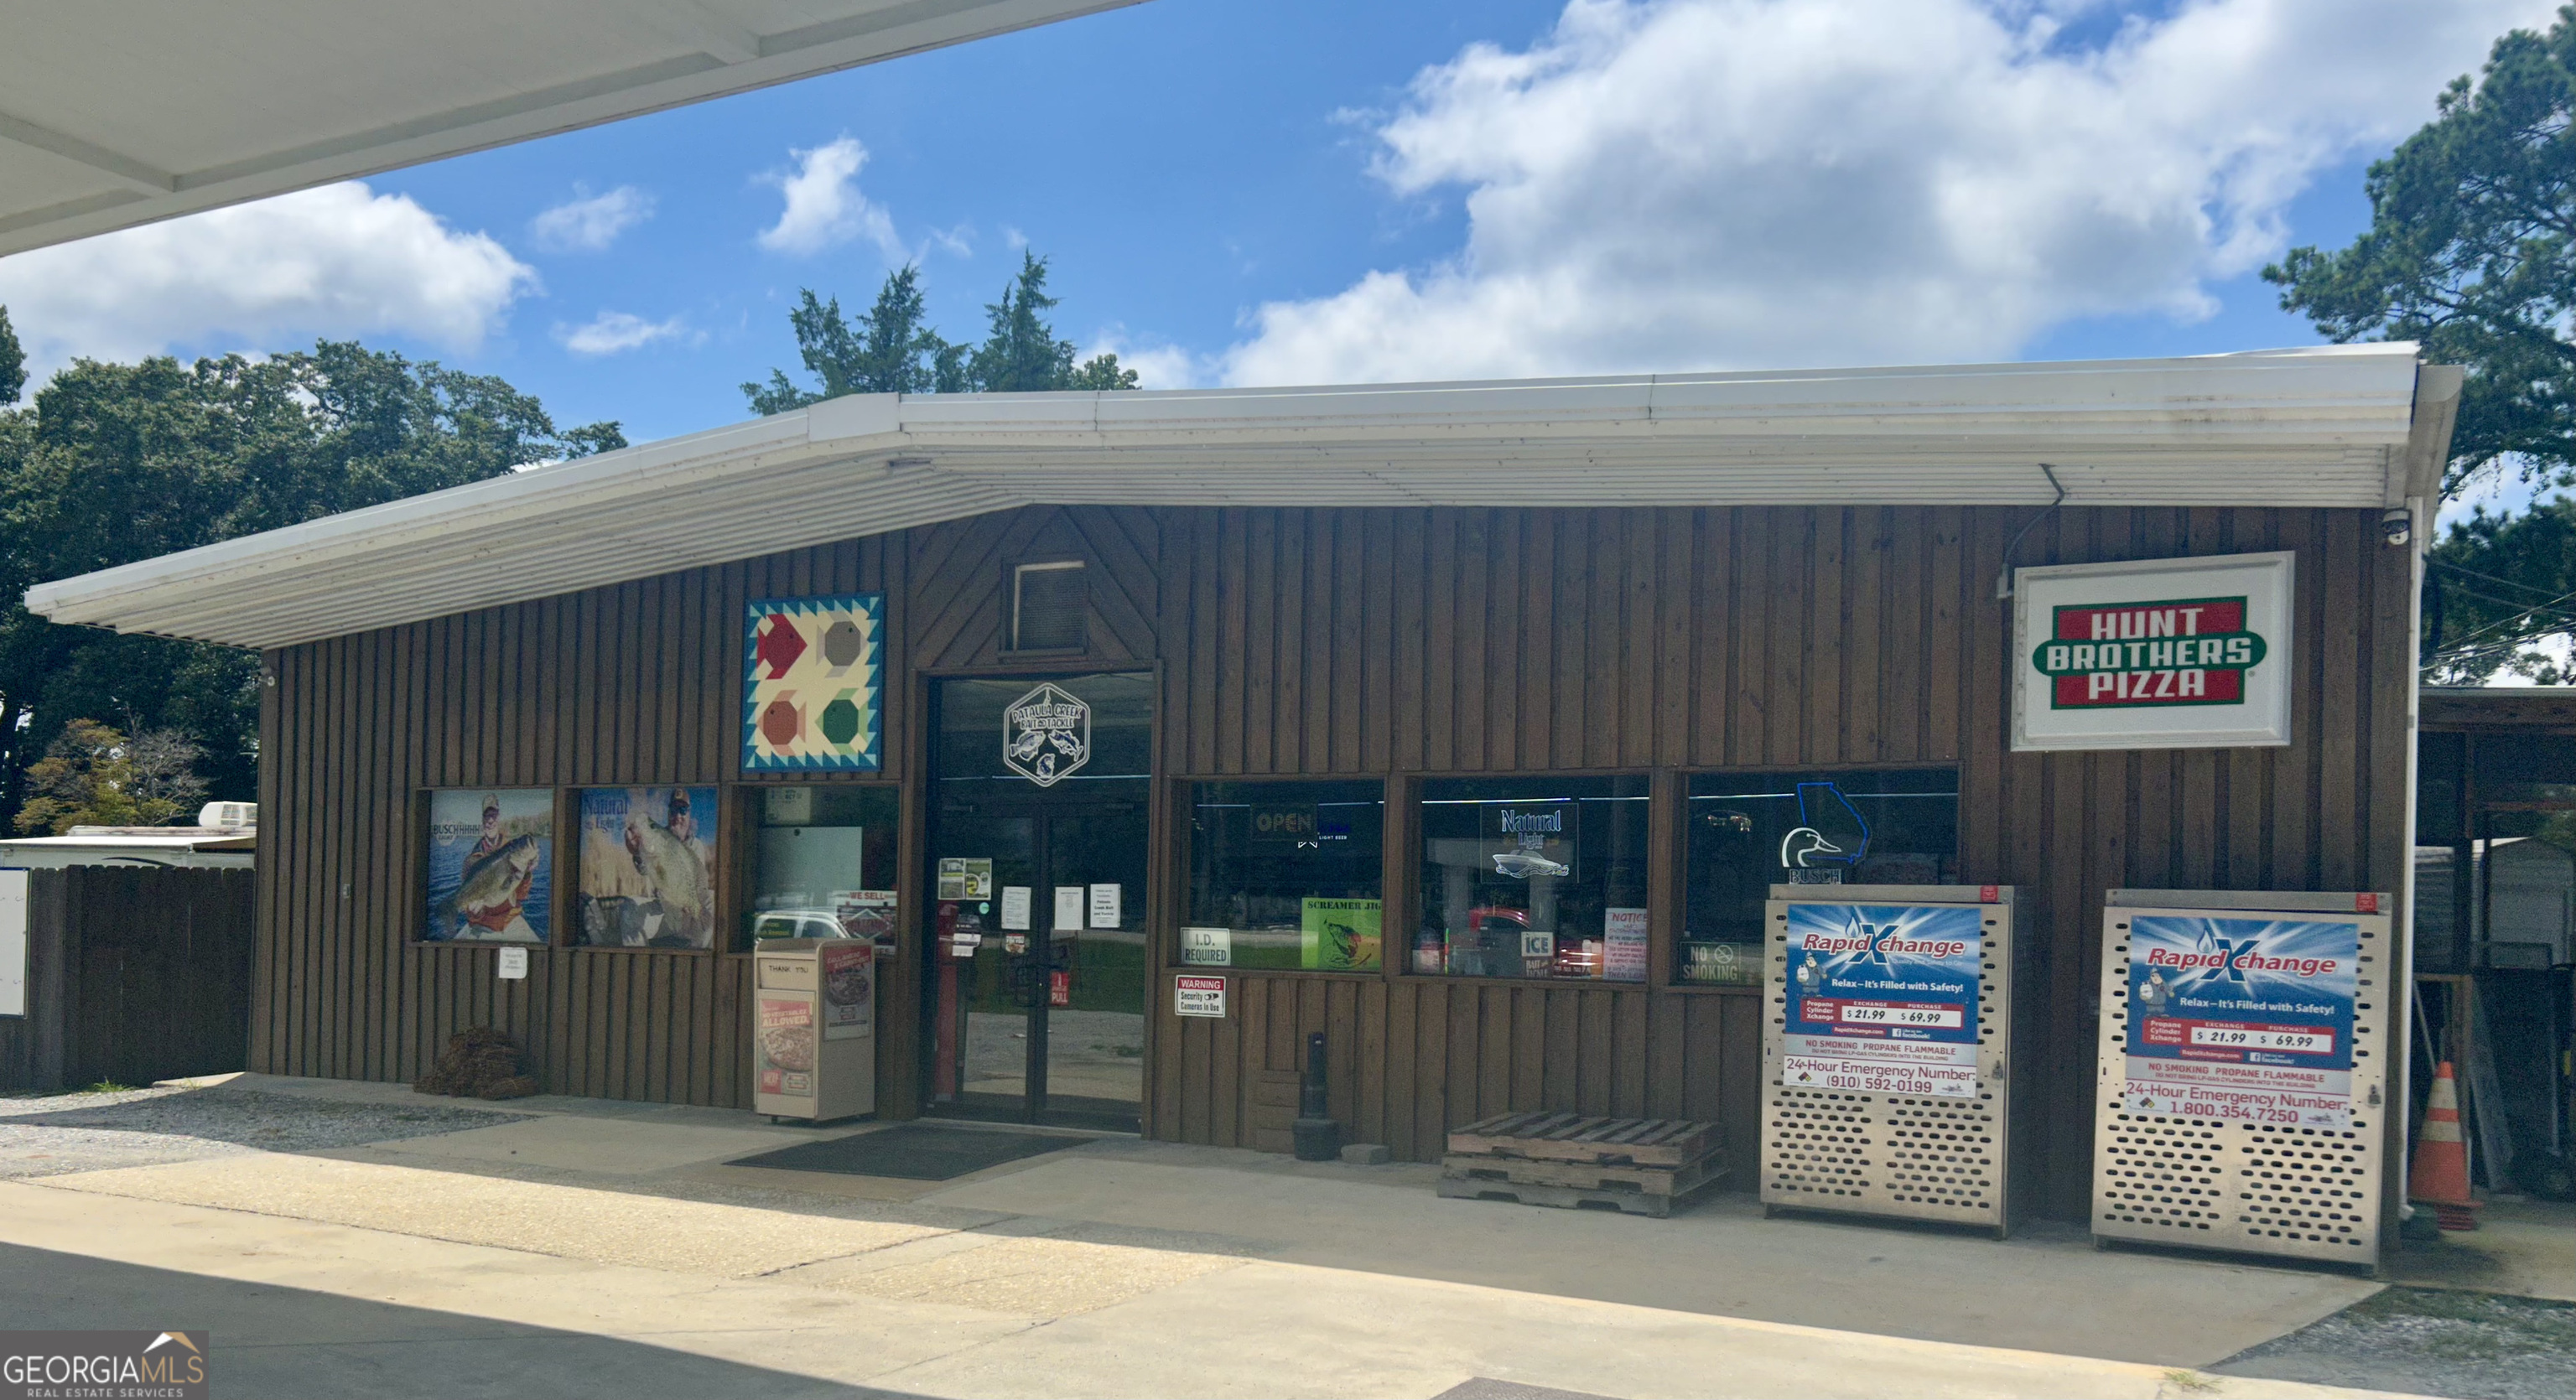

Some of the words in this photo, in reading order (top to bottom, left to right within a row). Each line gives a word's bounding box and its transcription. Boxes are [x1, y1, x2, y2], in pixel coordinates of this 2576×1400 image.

[2091, 607, 2204, 640] HUNT
[2046, 637, 2251, 671] BROTHERS
[2088, 668, 2205, 700] PIZZA
[1012, 703, 1052, 723] PATAULA
[1054, 703, 1082, 719] CREEK
[1021, 718, 1036, 730] BAIT
[1047, 718, 1074, 729] TACKLE
[584, 796, 629, 816] Natural
[596, 817, 615, 833] Light
[1257, 812, 1311, 832] OPEN
[1501, 810, 1561, 832] Natural
[1518, 832, 1545, 850] Light
[1789, 869, 1841, 884] BUSCH
[865, 892, 886, 900] SELL
[1307, 900, 1361, 910] SCREAMER
[1195, 933, 1216, 946] I.D.
[1185, 948, 1227, 963] REQUIRED
[1690, 946, 1708, 962] NO
[768, 965, 791, 973] THANK
[1683, 965, 1737, 981] SMOKING
[1181, 979, 1221, 990] WARNING
[1880, 981, 1906, 990] Filled
[1907, 982, 1929, 991] with
[1930, 983, 1964, 993] Safety!
[1181, 991, 1203, 1002] Security
[1181, 1002, 1203, 1011] Cameras
[1210, 1003, 1220, 1012] Use
[1806, 1000, 1834, 1009] Propane
[1806, 1007, 1834, 1015] Cylinder
[2236, 999, 2267, 1010] Filled
[2268, 1002, 2293, 1013] with
[2295, 1003, 2335, 1016] Safety!
[1806, 1013, 1835, 1021] Xchange
[1847, 1010, 1852, 1019] $
[1855, 1009, 1886, 1020] 21.99
[1901, 1012, 1906, 1021] $
[1909, 1013, 1941, 1023] 69.99
[1834, 1026, 1885, 1035] RapidXchange.com
[2150, 1020, 2182, 1029] Propane
[2268, 1025, 2309, 1034] PURCHASE
[2150, 1027, 2181, 1036] Cylinder
[2197, 1031, 2203, 1040] $
[2210, 1031, 2247, 1044] 21.99
[2150, 1034, 2182, 1044] Xchange
[2260, 1034, 2267, 1044] $
[2276, 1034, 2314, 1047] 69.99
[1805, 1039, 1818, 1048] NO
[1820, 1040, 1858, 1050] SMOKING
[1863, 1042, 1902, 1053] PROPANE
[1904, 1045, 1956, 1056] FLAMMABLE
[1786, 1058, 1839, 1072] 24-Hour
[1841, 1060, 1914, 1078] Emergency
[1919, 1066, 1976, 1081] Number:
[2148, 1062, 2162, 1071] NO
[2164, 1063, 2210, 1075] SMOKING
[2215, 1067, 2260, 1078] PROPANE
[2264, 1071, 2325, 1083] FLAMMABLE
[1826, 1075, 1861, 1088] (910)
[1865, 1078, 1933, 1093] 592-0199
[2126, 1081, 2186, 1098] 24-Hour
[2189, 1086, 2274, 1107] Emergency
[2280, 1093, 2348, 1111] Number:
[2169, 1101, 2299, 1123] 1.800.354.7250
